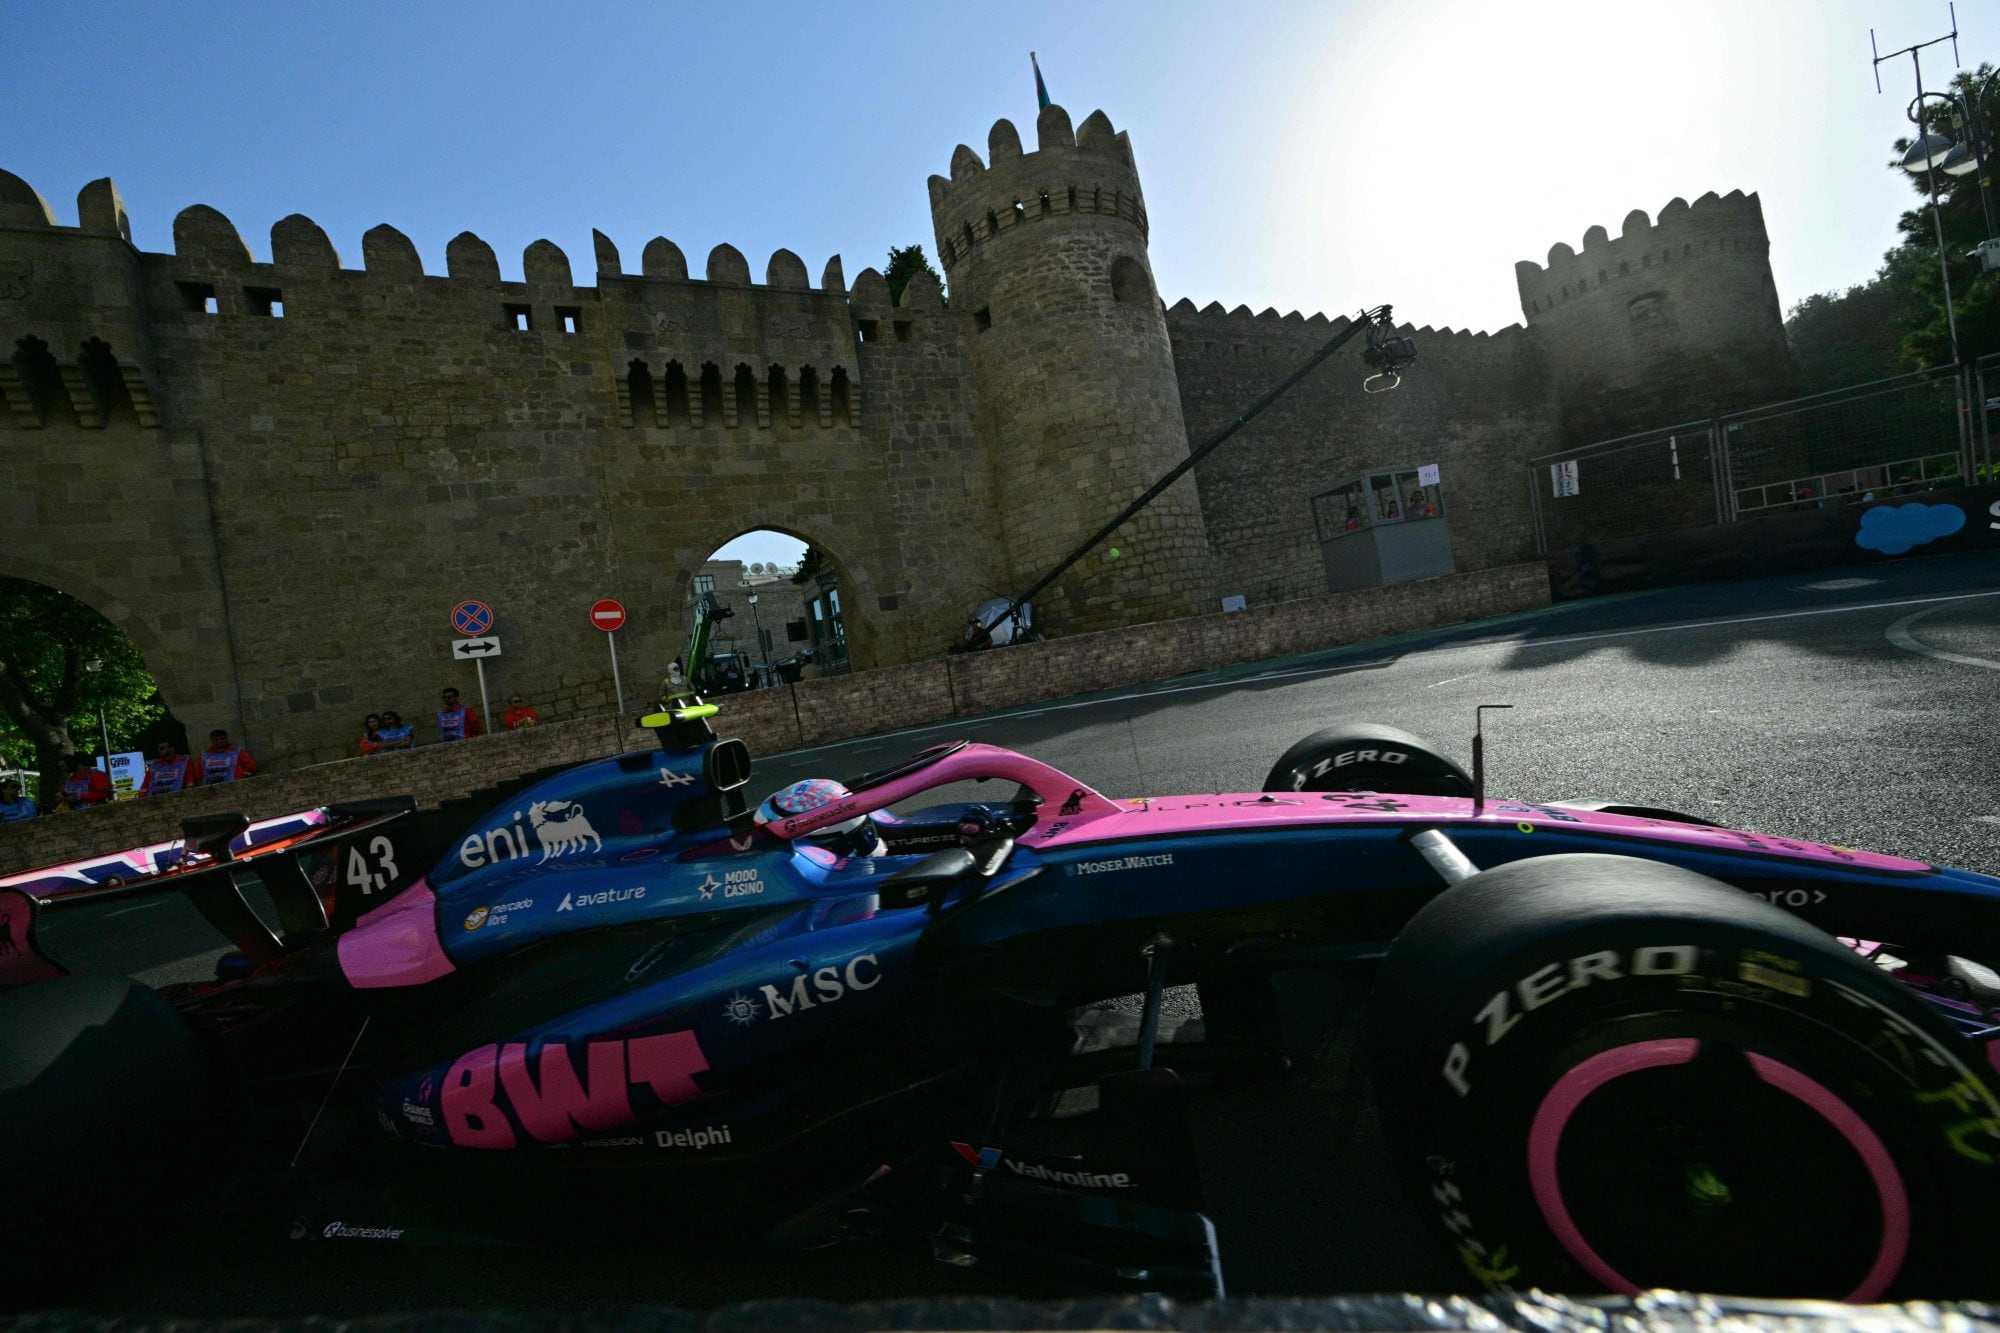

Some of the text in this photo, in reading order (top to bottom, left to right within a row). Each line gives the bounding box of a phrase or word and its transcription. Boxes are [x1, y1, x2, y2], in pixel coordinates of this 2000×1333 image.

[1313, 749, 1408, 778] ZERO
[460, 810, 530, 868] eni
[346, 835, 399, 895] 43
[724, 868, 757, 885] MODO
[576, 884, 646, 907] avature
[724, 881, 764, 898] CASINO
[490, 898, 533, 912] mercado
[486, 913, 508, 927] libre
[758, 952, 882, 1020] MSC
[1441, 1042, 1471, 1098] P
[1473, 944, 1699, 1046] ZERO
[440, 1029, 712, 1150] BWT
[655, 1124, 732, 1150] Delphi
[1003, 1158, 1131, 1188] Valvoline
